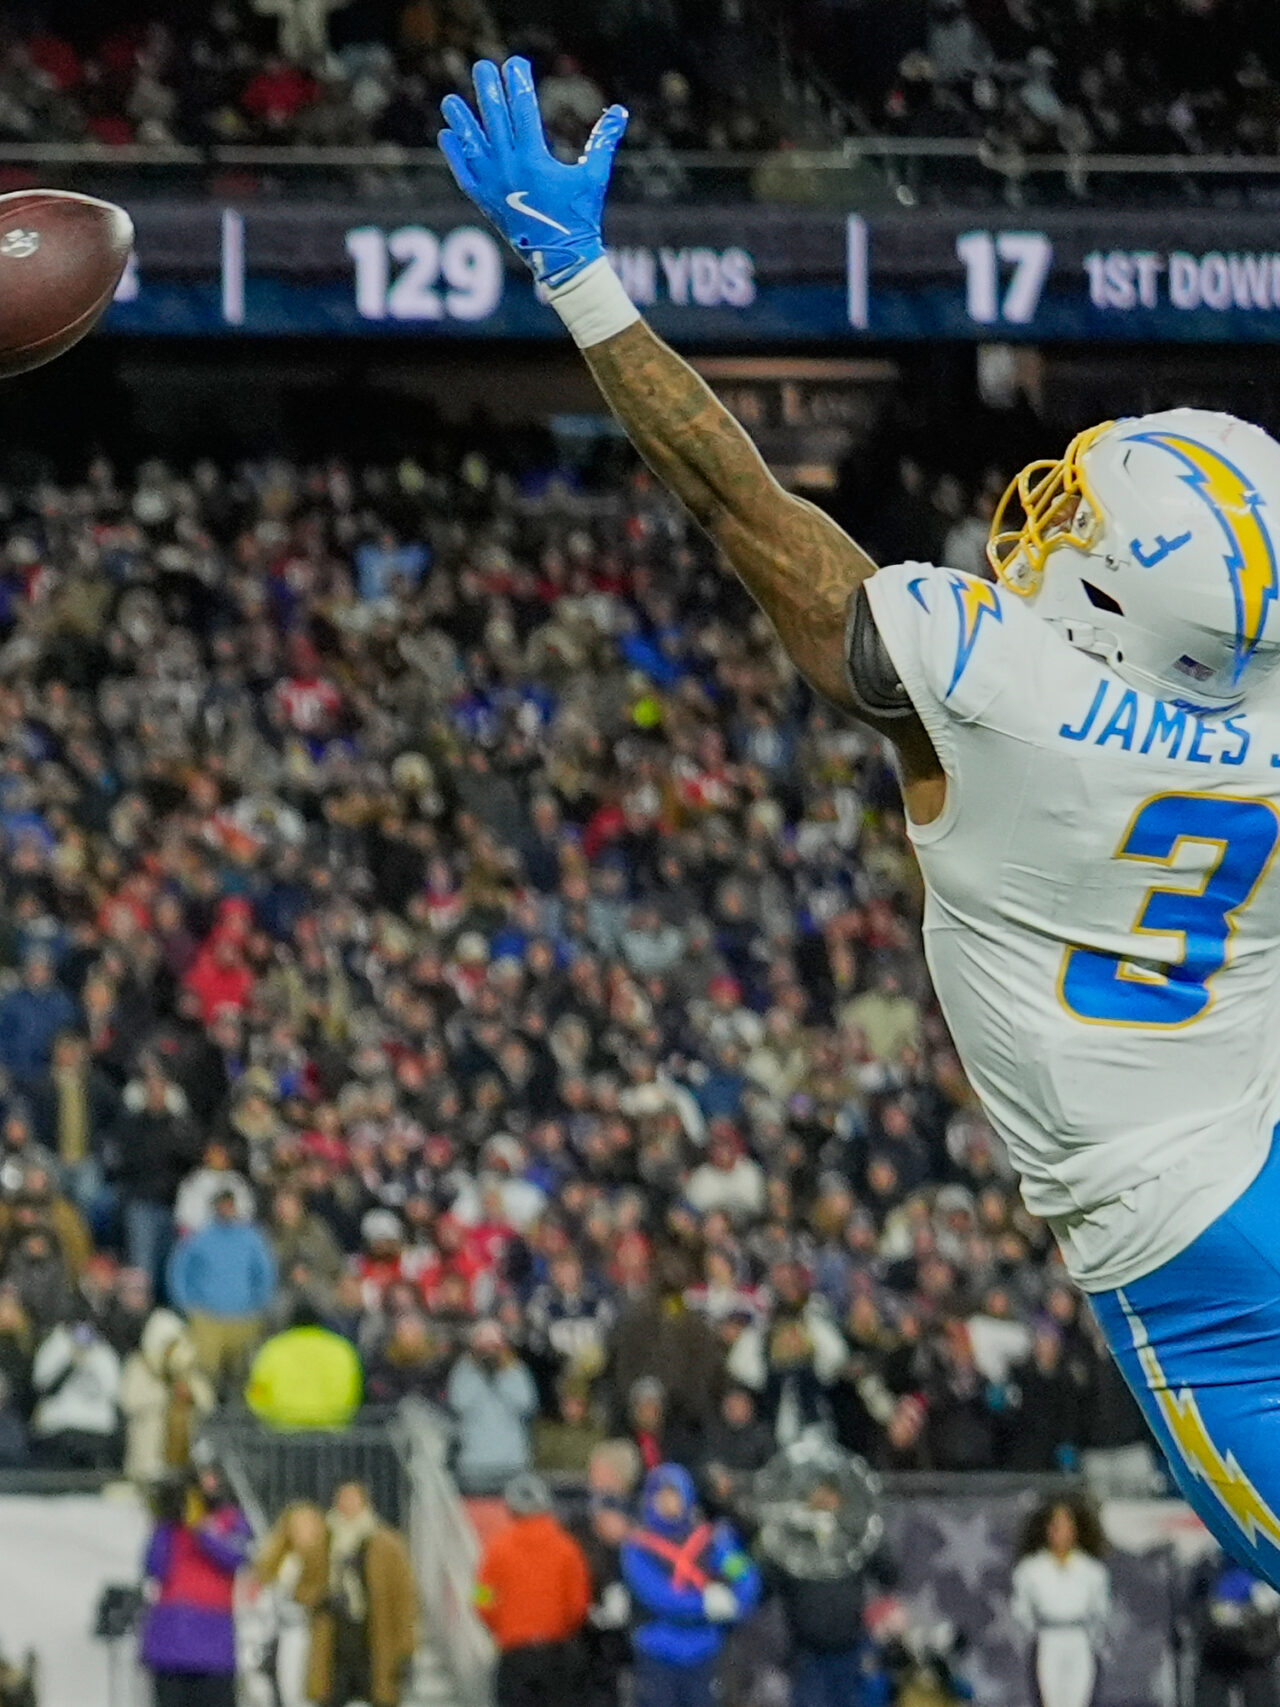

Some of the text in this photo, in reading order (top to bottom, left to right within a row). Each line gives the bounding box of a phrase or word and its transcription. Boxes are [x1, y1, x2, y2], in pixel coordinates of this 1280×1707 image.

[345, 225, 503, 321] 129
[661, 247, 756, 307] YDS
[957, 230, 1053, 324] 17
[1084, 250, 1163, 309] 1ST
[1059, 679, 1250, 766] JAMES
[1056, 790, 1280, 1031] 3
